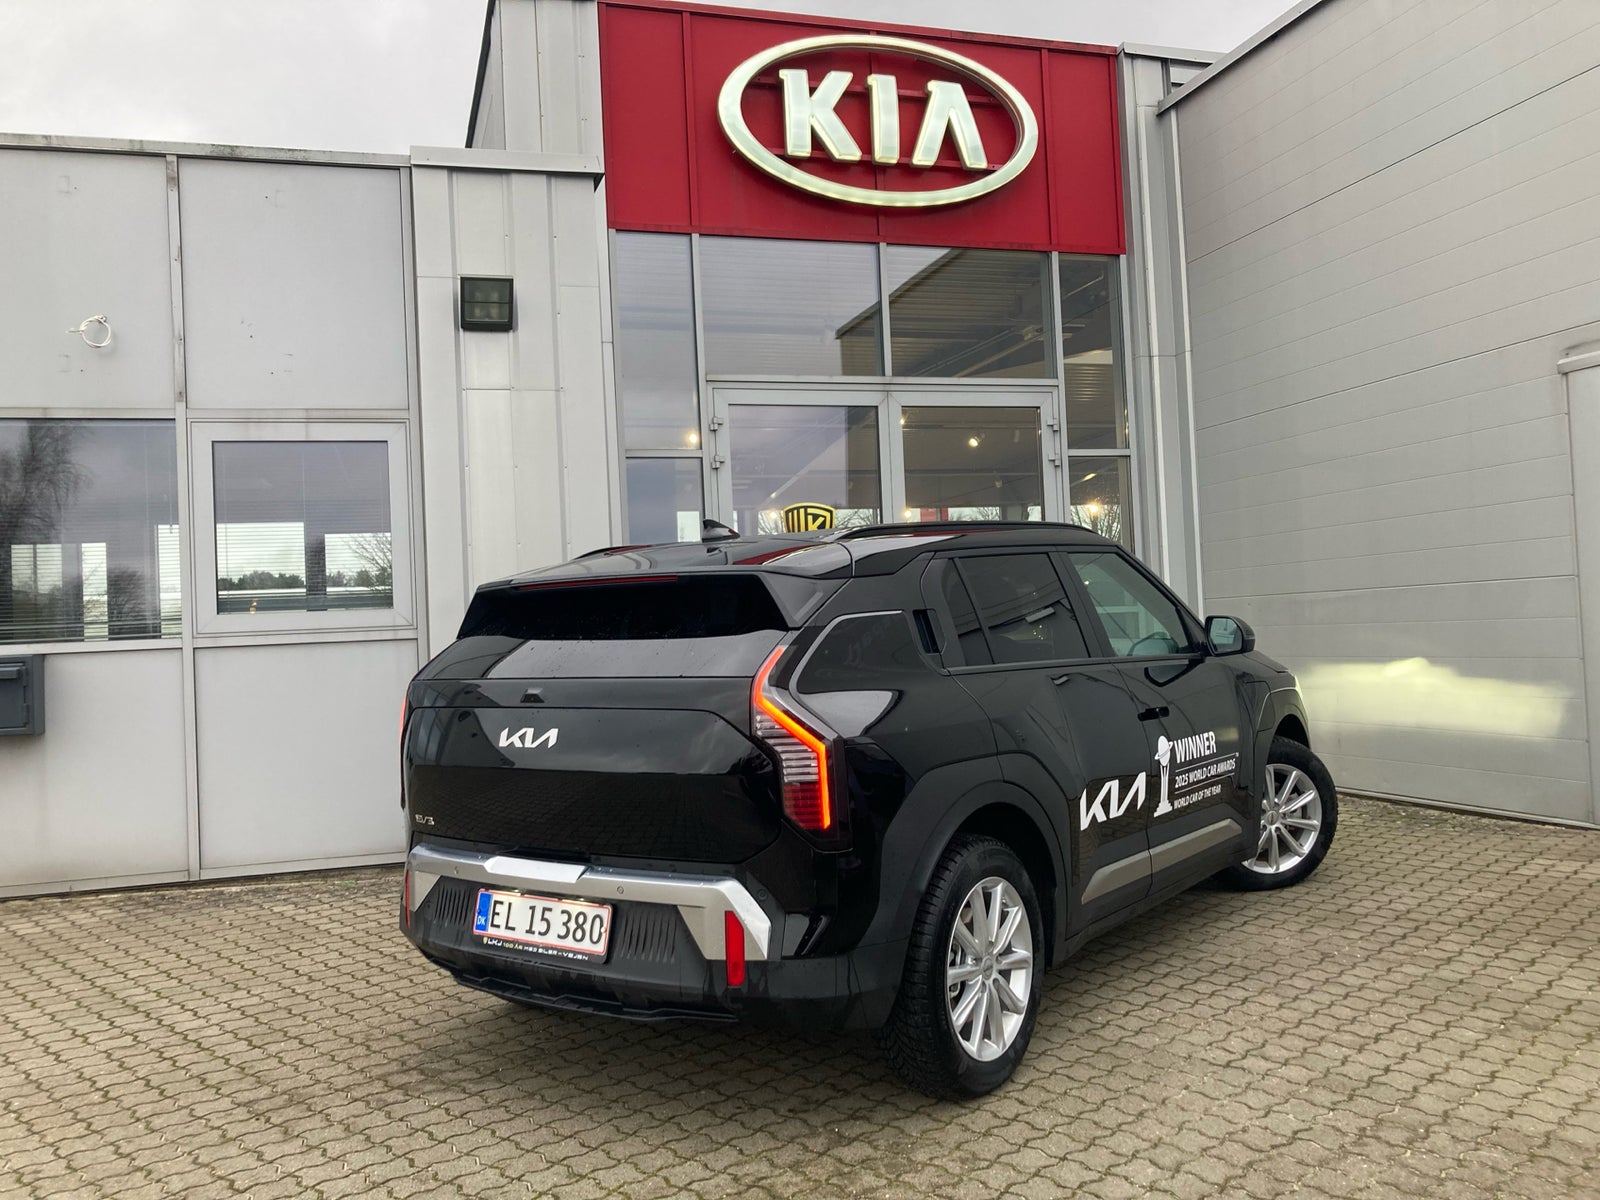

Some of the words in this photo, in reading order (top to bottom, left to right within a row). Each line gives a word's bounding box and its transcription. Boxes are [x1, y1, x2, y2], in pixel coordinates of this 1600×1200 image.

[779, 69, 988, 169] KIA
[499, 727, 559, 748] KIA
[1174, 731, 1217, 764] WINNER
[1175, 773, 1189, 788] 2025
[1189, 767, 1207, 783] WORLD
[1207, 764, 1217, 777] CAR
[1217, 758, 1236, 774] AWARDS
[1080, 771, 1147, 831] KIA
[1173, 795, 1190, 810] WORLD
[1190, 792, 1199, 804] CAR
[1198, 789, 1204, 801] OF
[1204, 787, 1212, 799] THE
[1211, 784, 1222, 796] YEAR
[477, 915, 487, 926] DK
[490, 900, 516, 931] EL
[525, 905, 553, 936] 15
[557, 909, 604, 944] 380
